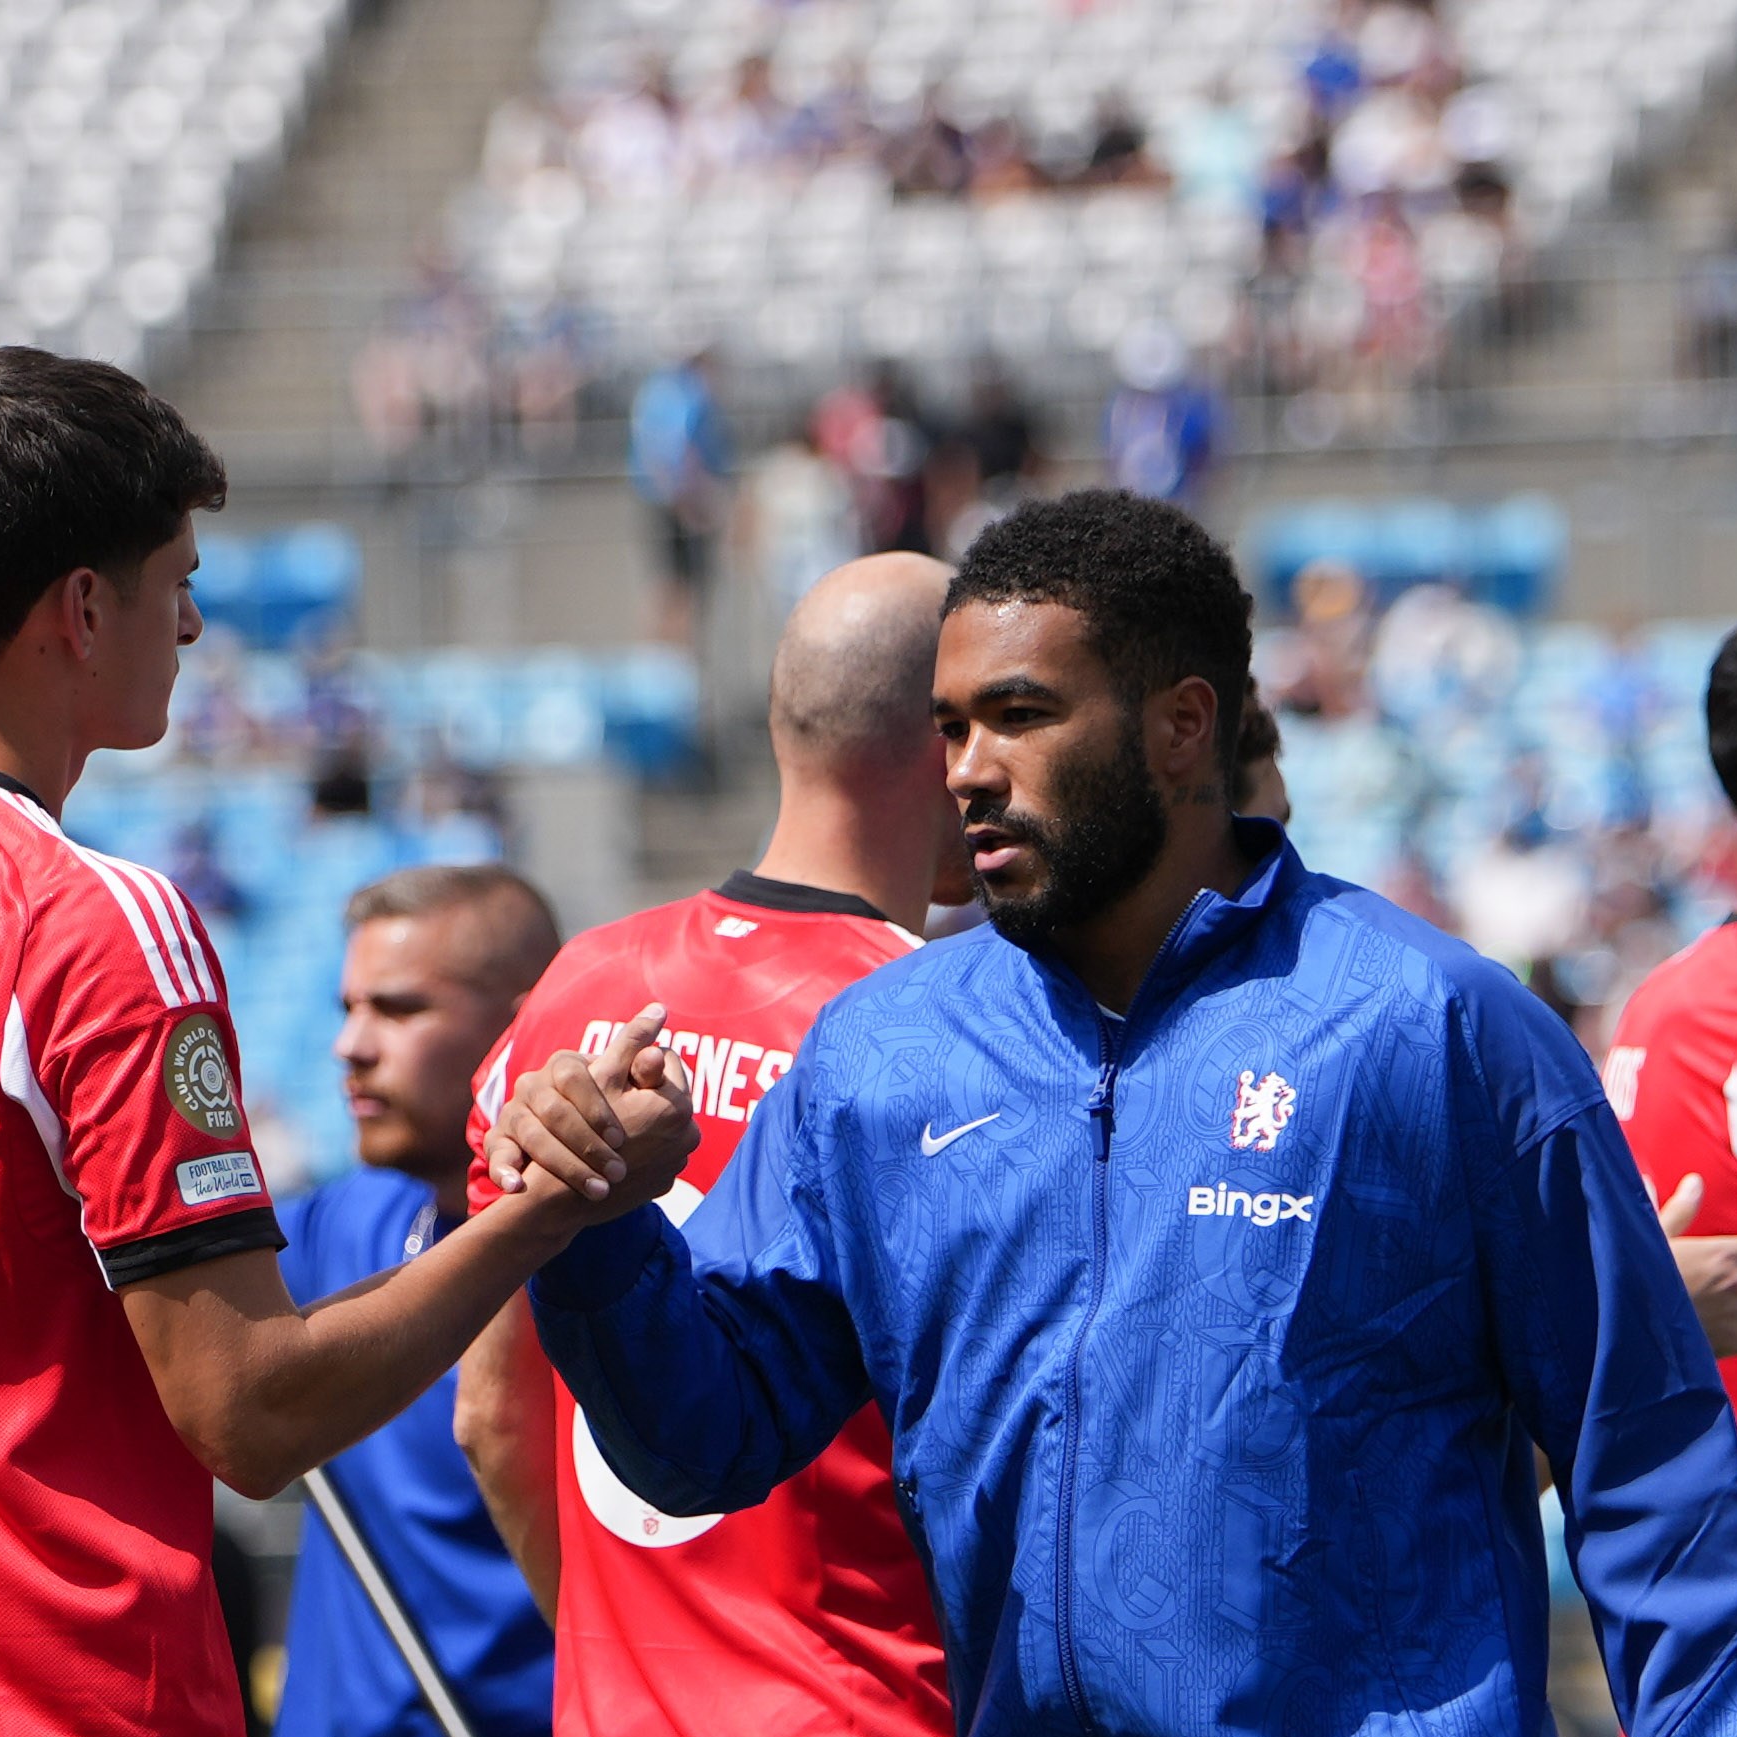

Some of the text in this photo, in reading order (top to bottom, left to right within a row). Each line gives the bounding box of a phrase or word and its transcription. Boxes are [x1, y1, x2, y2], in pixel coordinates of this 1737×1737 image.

[173, 1026, 206, 1067] WORLD
[174, 1073, 199, 1112] CLUB
[205, 1110, 235, 1129] FIFA
[188, 1157, 232, 1180] FOOTBALL
